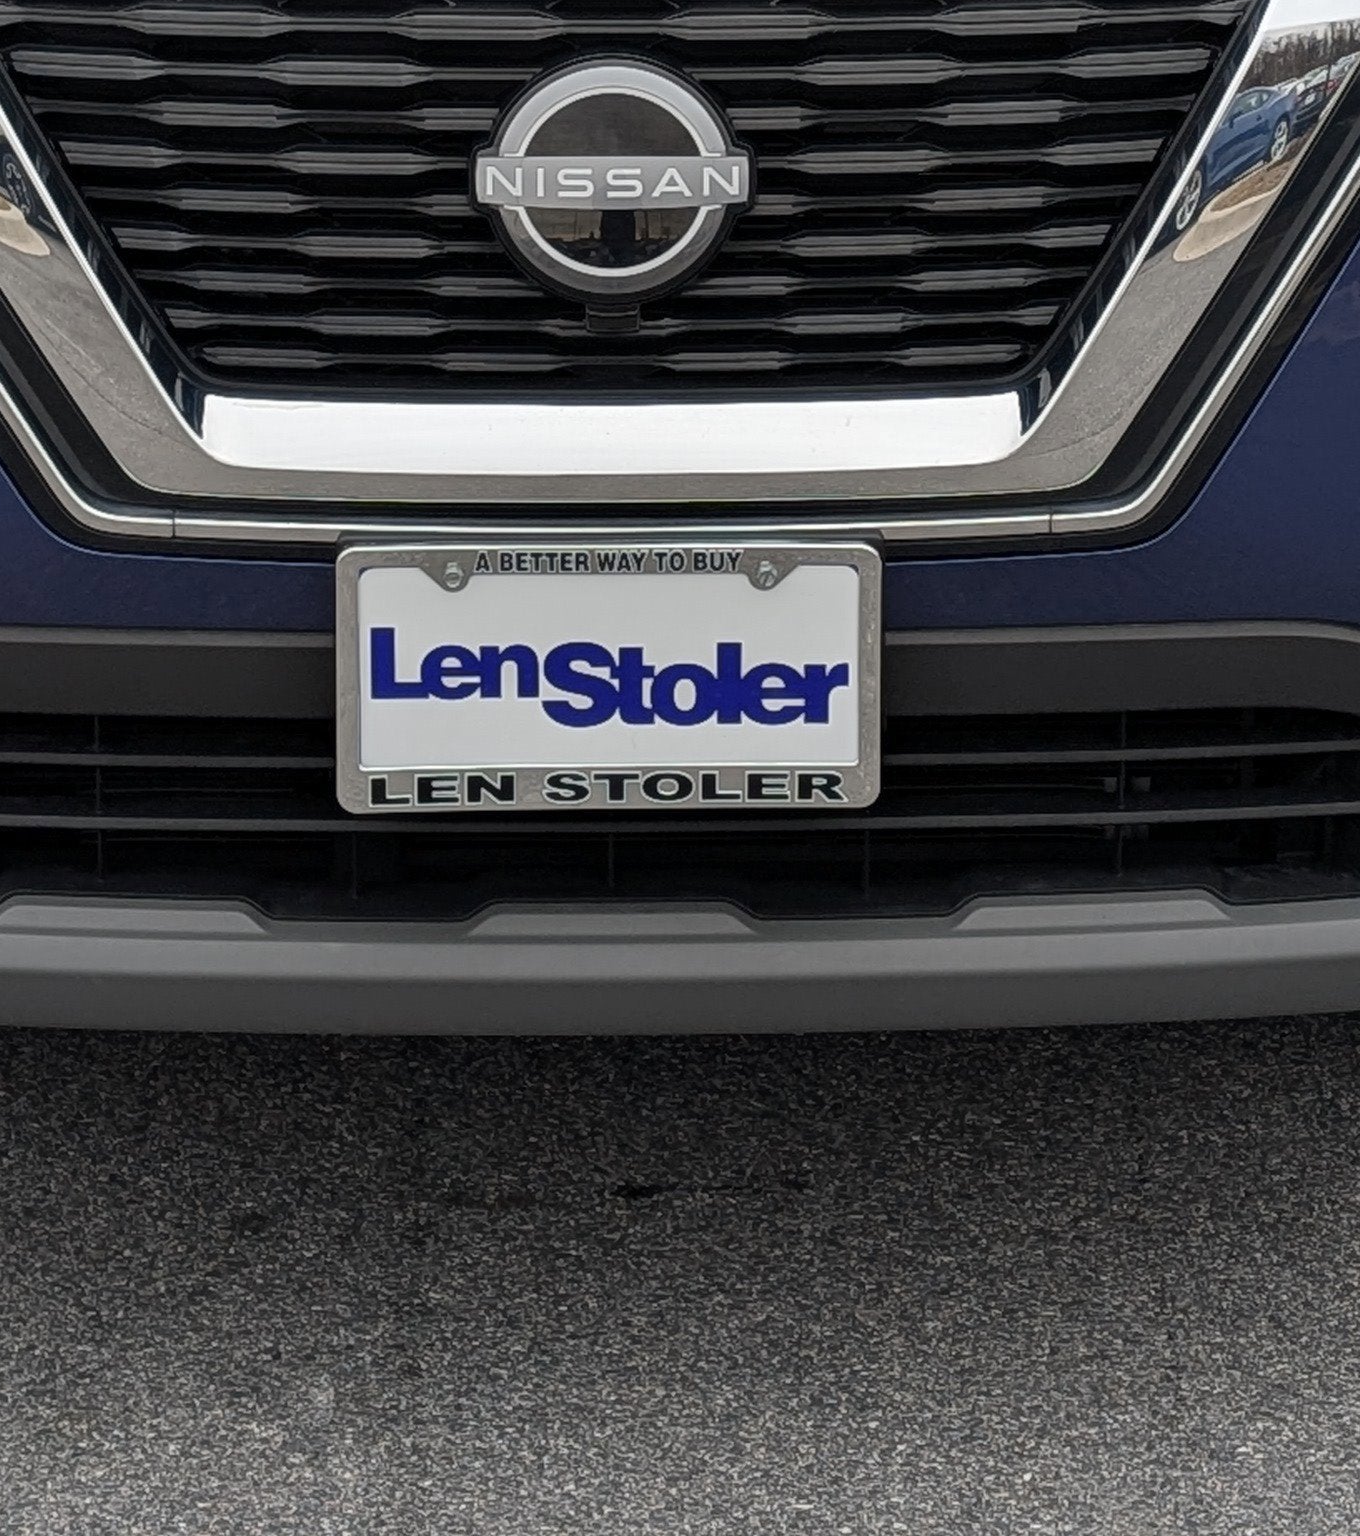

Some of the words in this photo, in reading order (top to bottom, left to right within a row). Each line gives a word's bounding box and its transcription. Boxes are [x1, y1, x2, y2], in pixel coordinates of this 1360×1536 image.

[485, 165, 740, 198] NISSAN
[475, 552, 490, 573] A
[500, 552, 589, 574] BETTER
[596, 551, 646, 573] WAY
[653, 551, 685, 573] TO
[692, 550, 743, 573] BUY
[369, 773, 517, 807] LEN
[542, 772, 850, 805] STOLER
